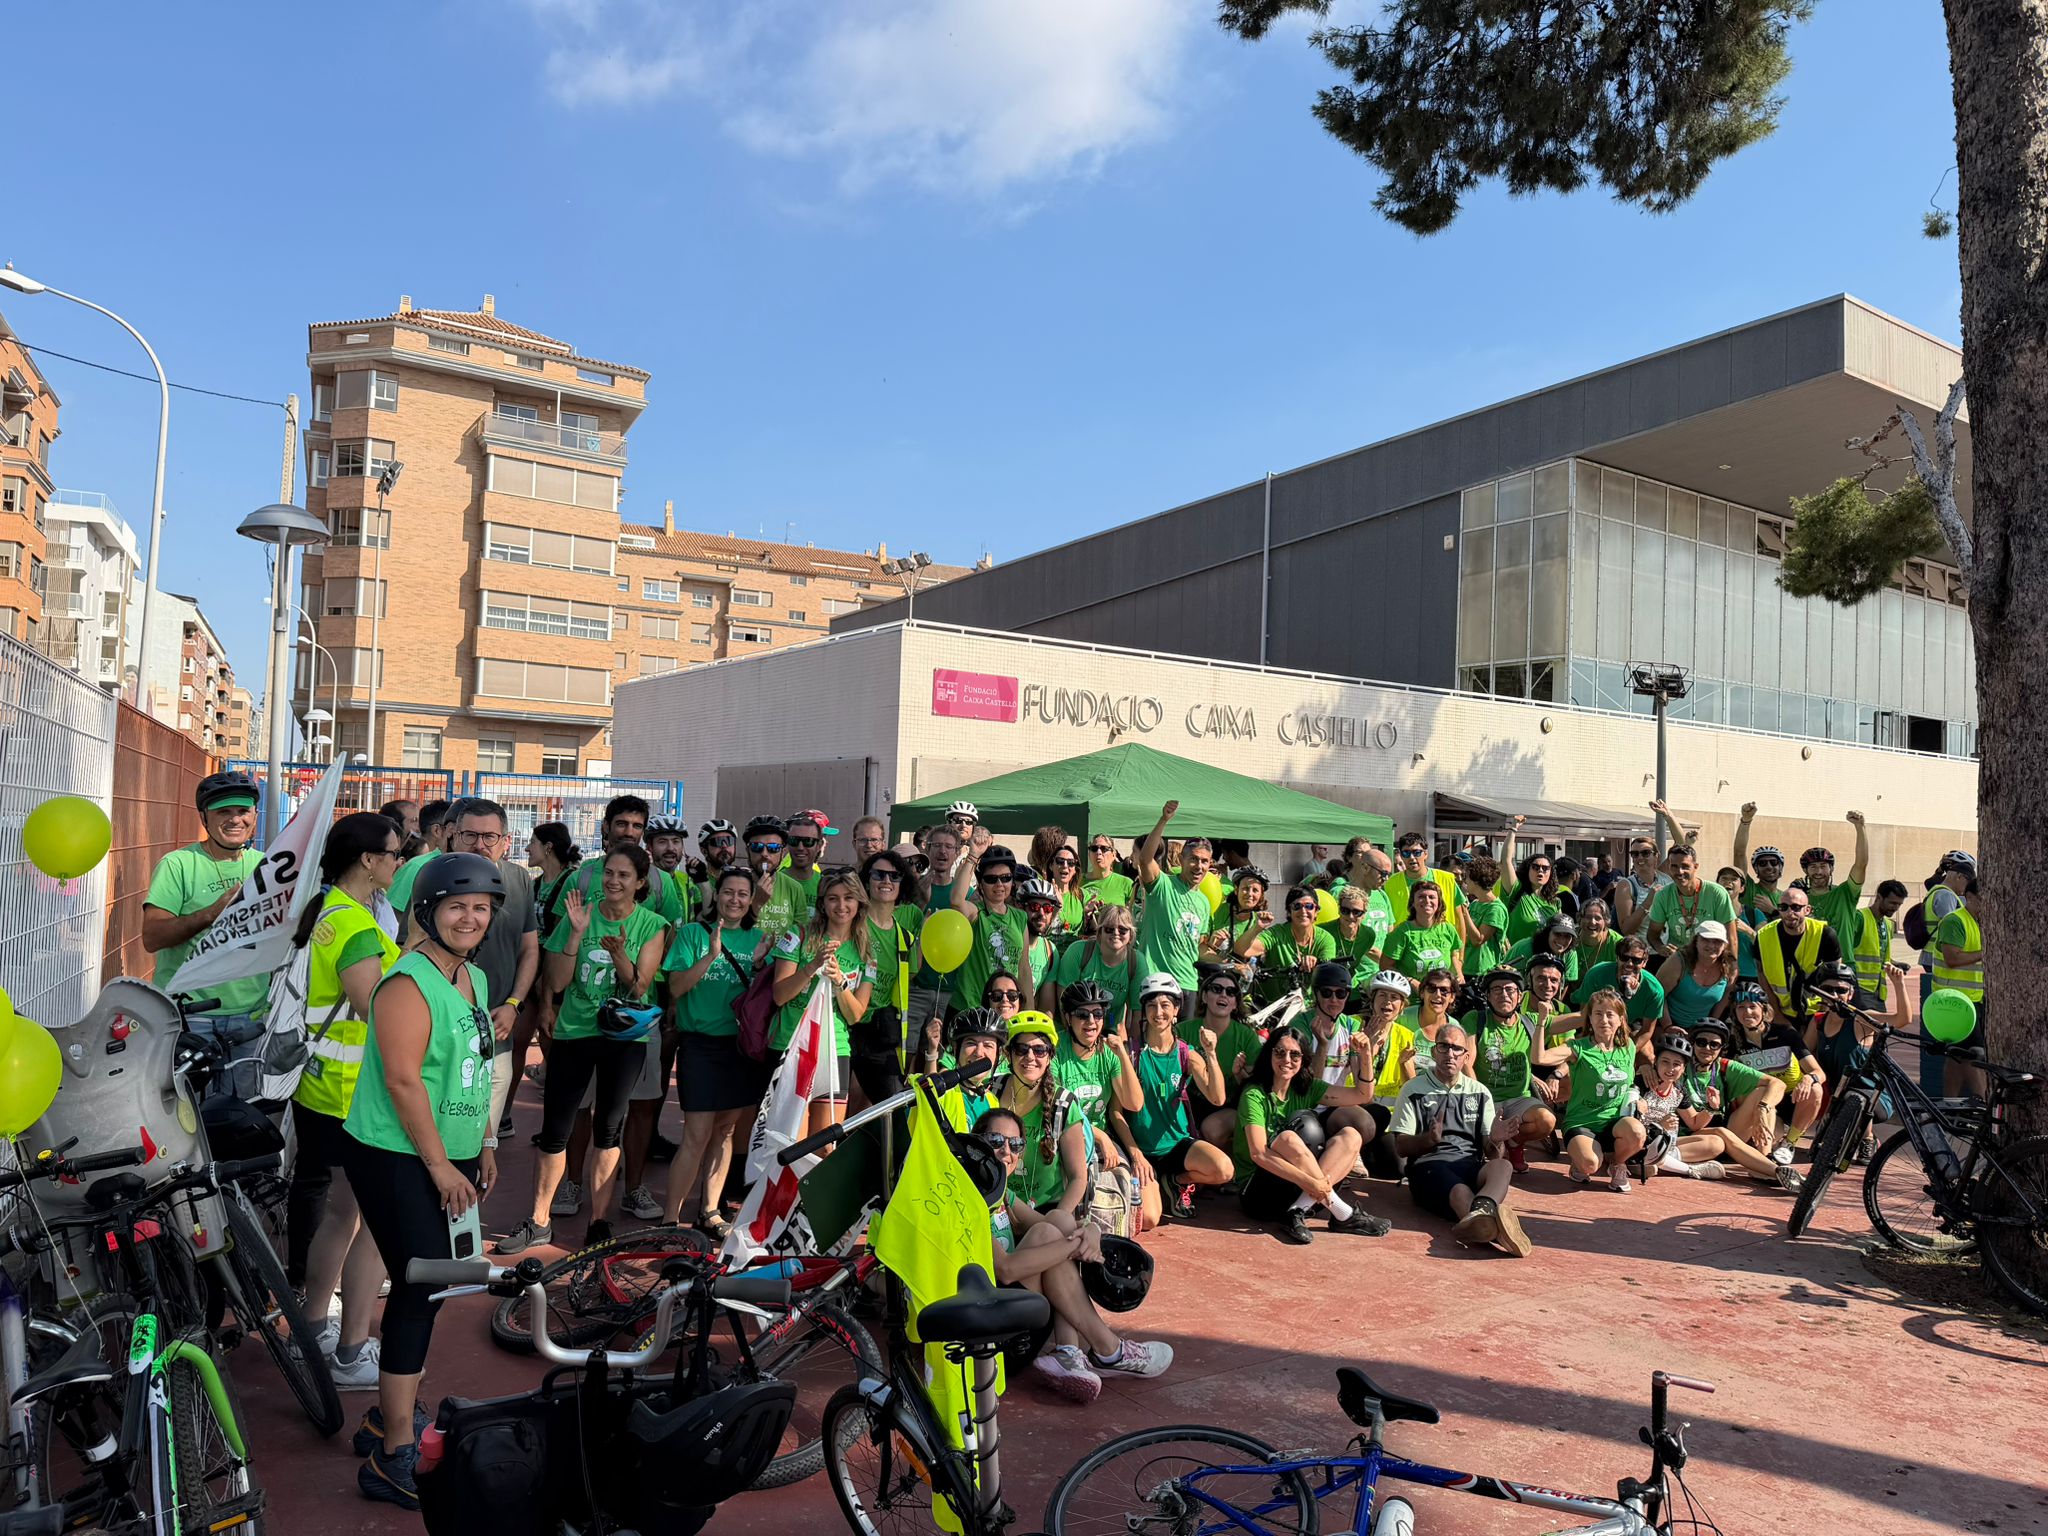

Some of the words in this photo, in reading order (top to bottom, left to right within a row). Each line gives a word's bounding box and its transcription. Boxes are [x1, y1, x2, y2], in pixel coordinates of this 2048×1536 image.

[963, 695, 983, 705] CAIXA
[1185, 703, 1257, 742] CAIXA
[566, 1238, 617, 1263] MAXXIS
